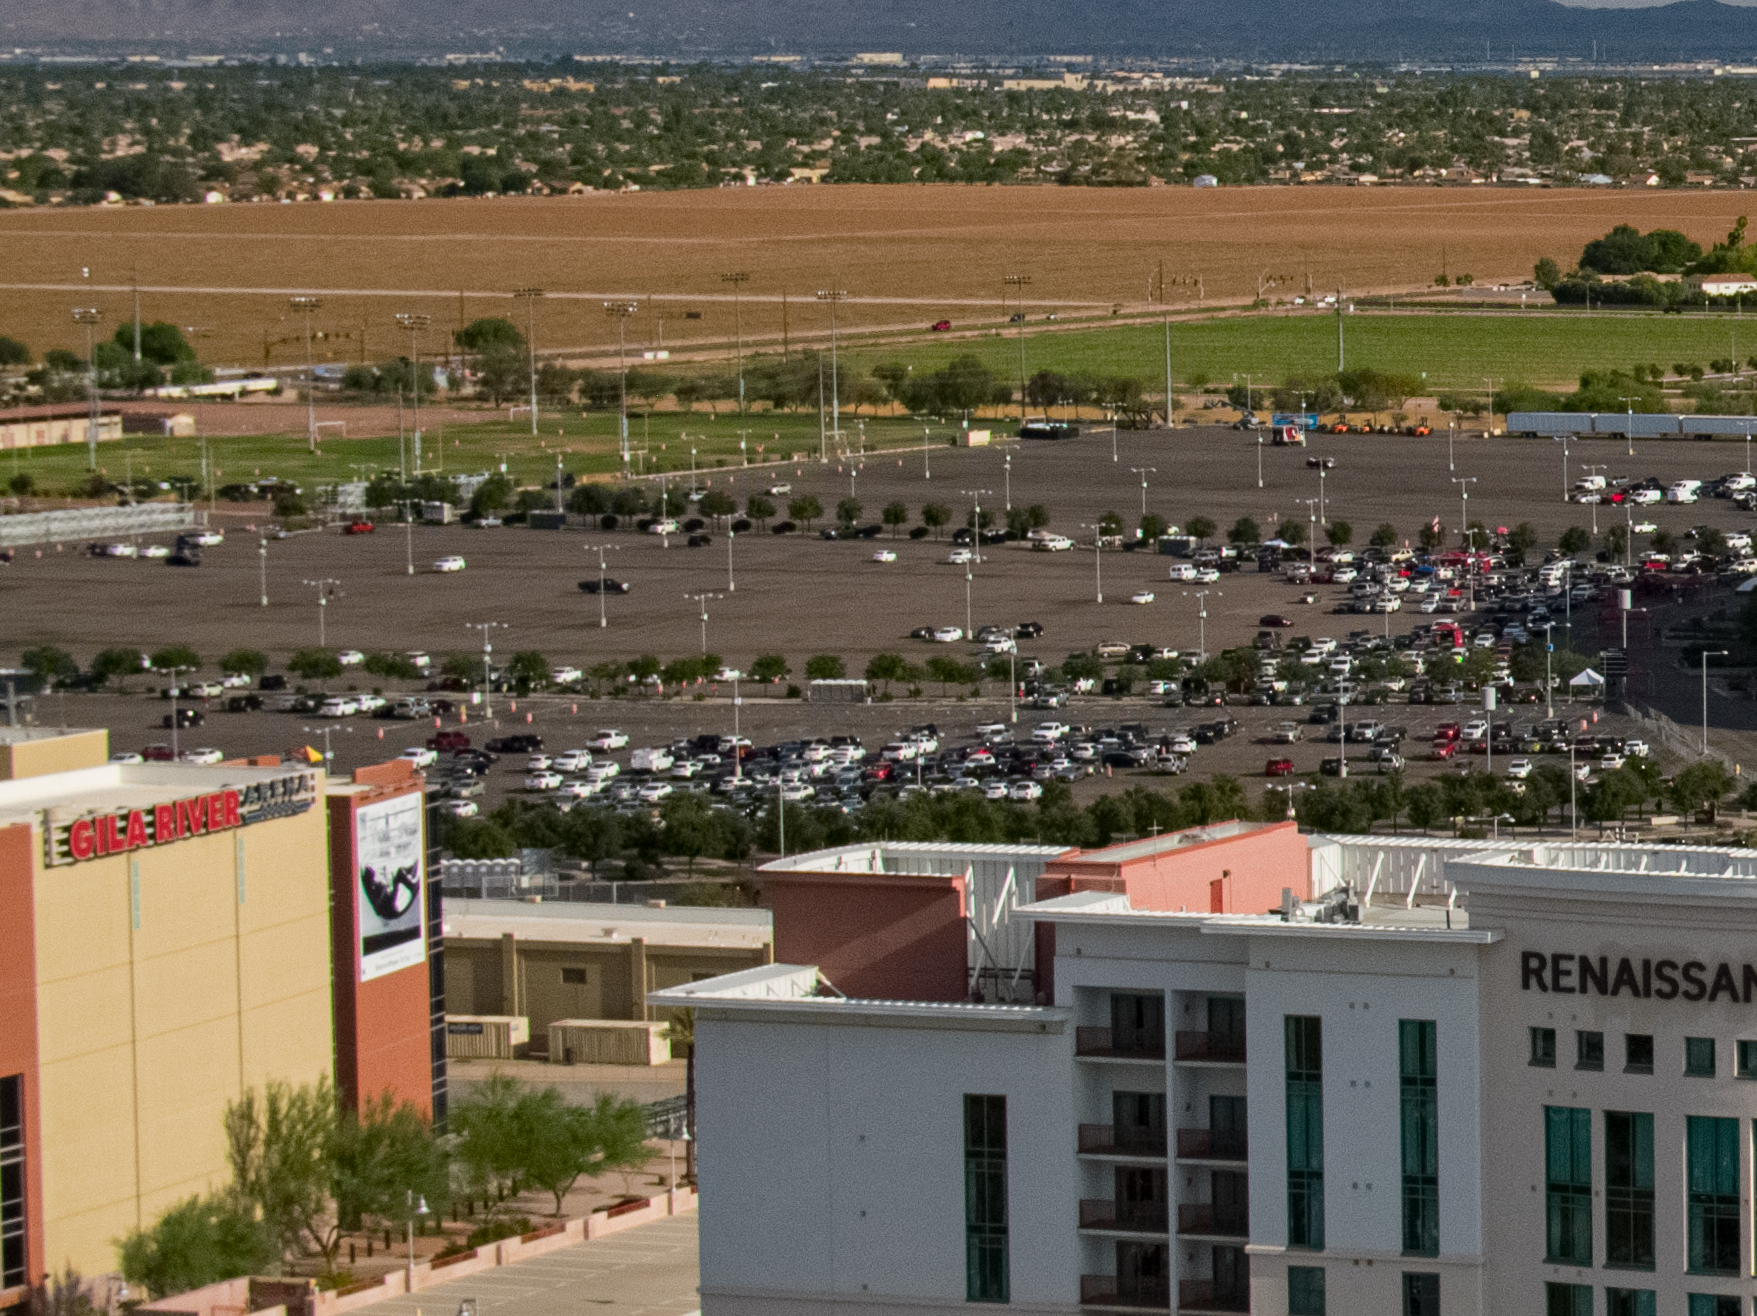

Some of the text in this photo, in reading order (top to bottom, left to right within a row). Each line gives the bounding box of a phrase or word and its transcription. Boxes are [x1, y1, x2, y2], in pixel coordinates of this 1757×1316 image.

[70, 810, 148, 860] GILA
[154, 789, 241, 844] RIVER
[243, 773, 310, 806] ARENA
